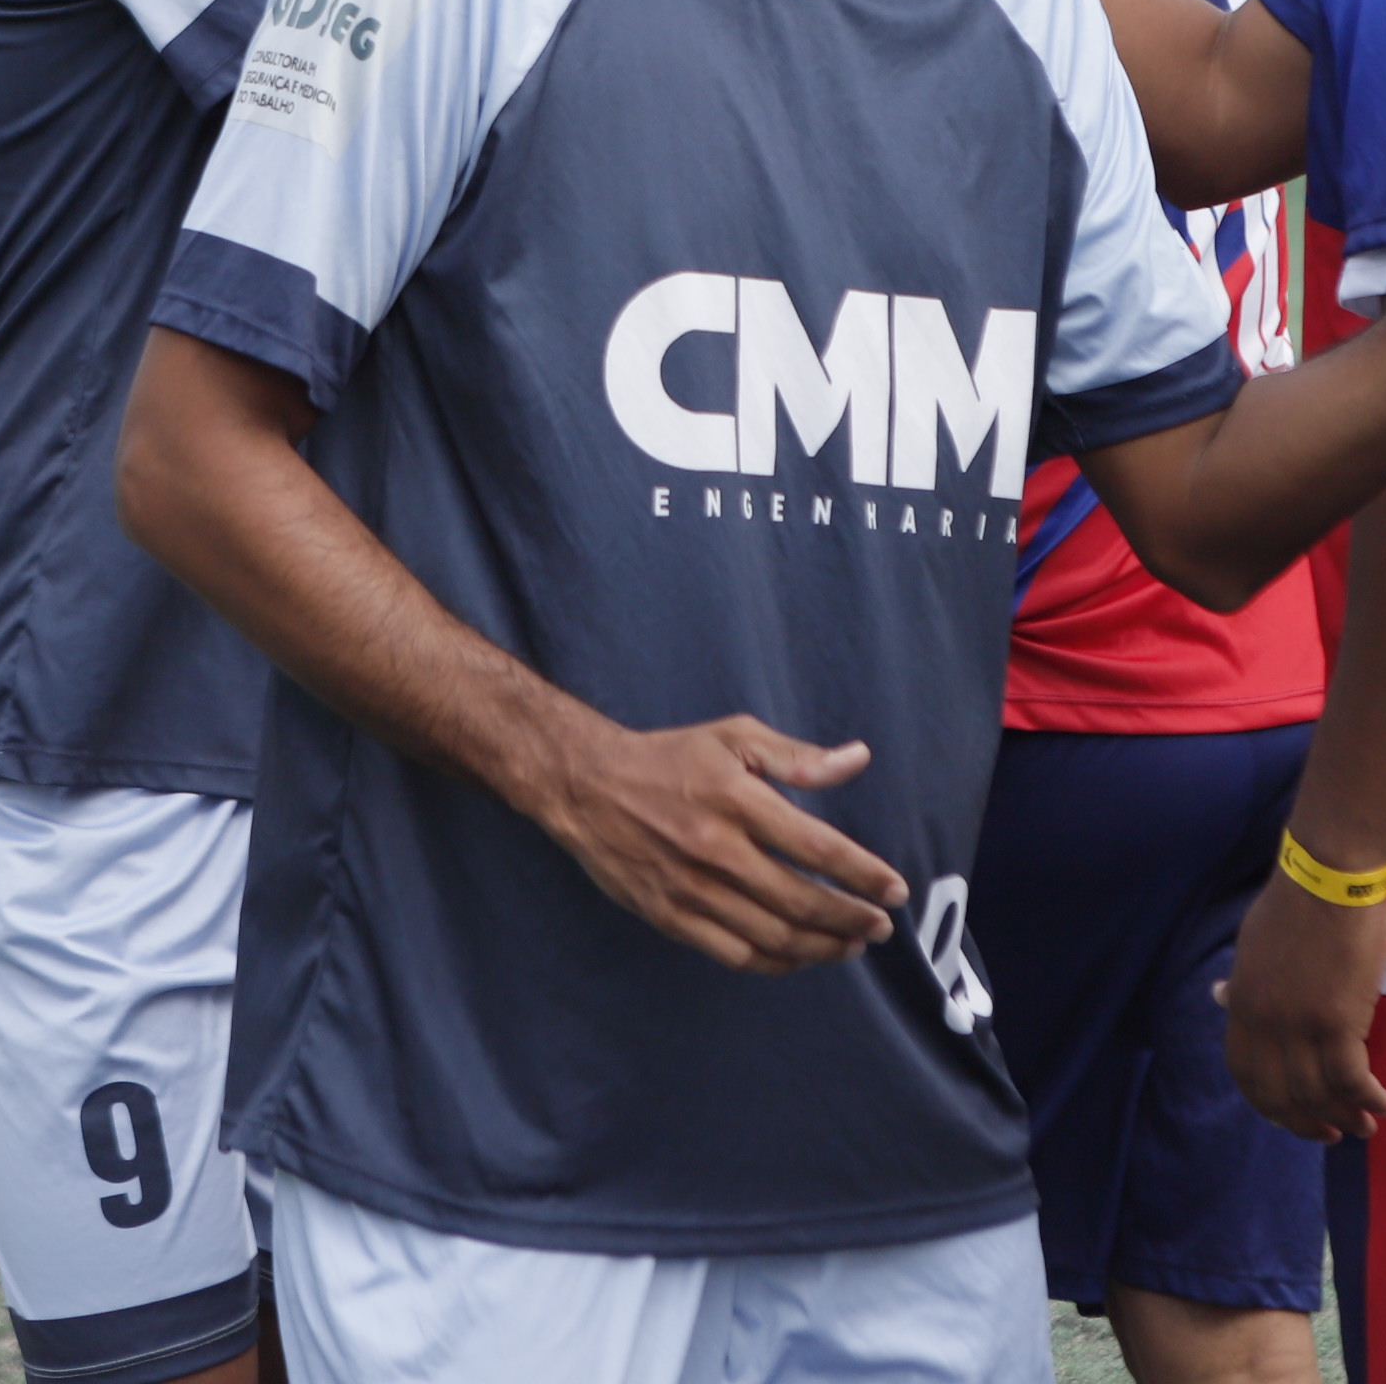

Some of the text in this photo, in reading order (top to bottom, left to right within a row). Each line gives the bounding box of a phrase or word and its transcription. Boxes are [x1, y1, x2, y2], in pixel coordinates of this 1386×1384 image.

[603, 271, 1038, 501] CMM
[653, 486, 1019, 546] ENGENHARIA
[79, 1080, 174, 1229] 9
